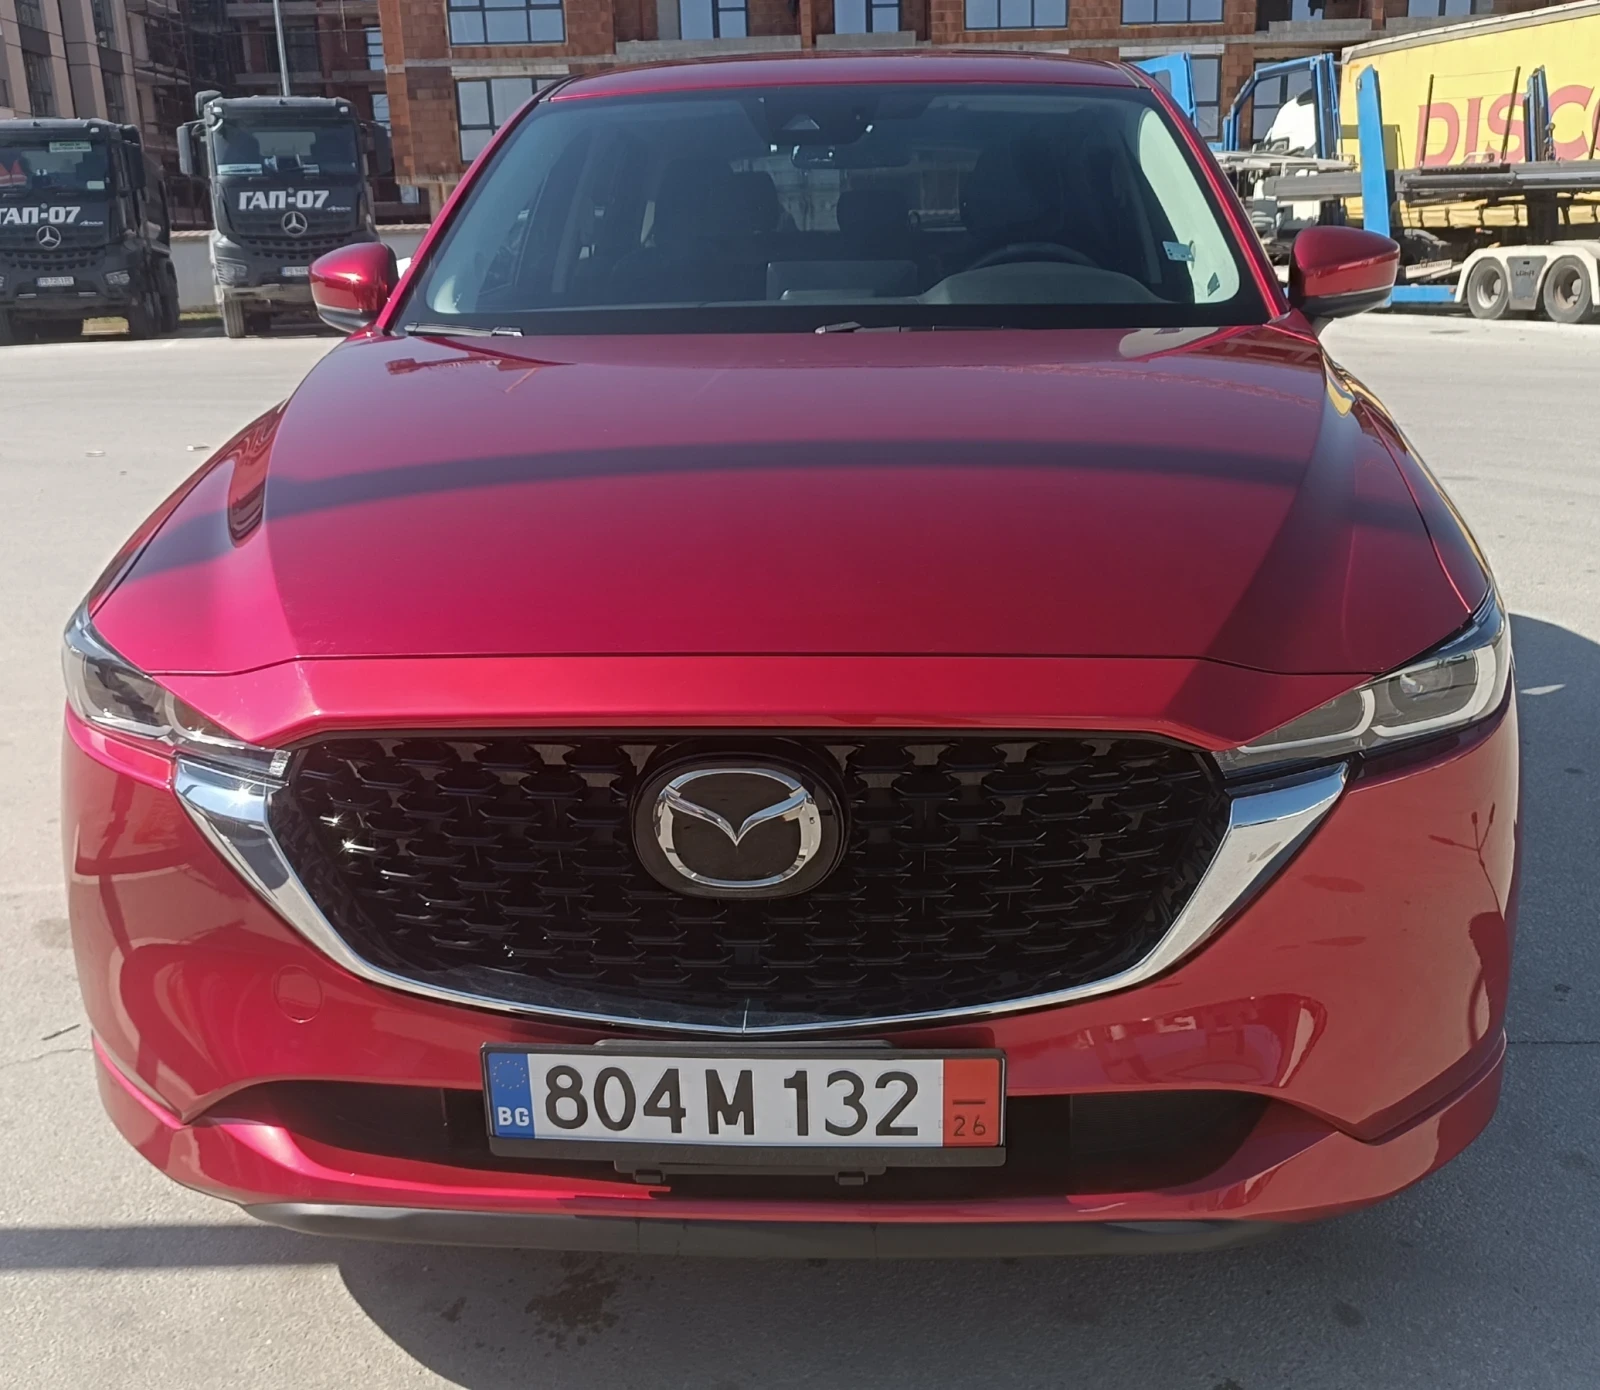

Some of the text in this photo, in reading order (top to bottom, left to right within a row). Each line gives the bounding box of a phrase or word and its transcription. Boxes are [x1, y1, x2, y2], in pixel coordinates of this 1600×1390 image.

[1414, 84, 1600, 168] DISC
[238, 190, 330, 210] ГАП-07
[545, 1064, 919, 1137] 804 M 132
[497, 1106, 531, 1127] BG
[953, 1114, 987, 1137] 26
